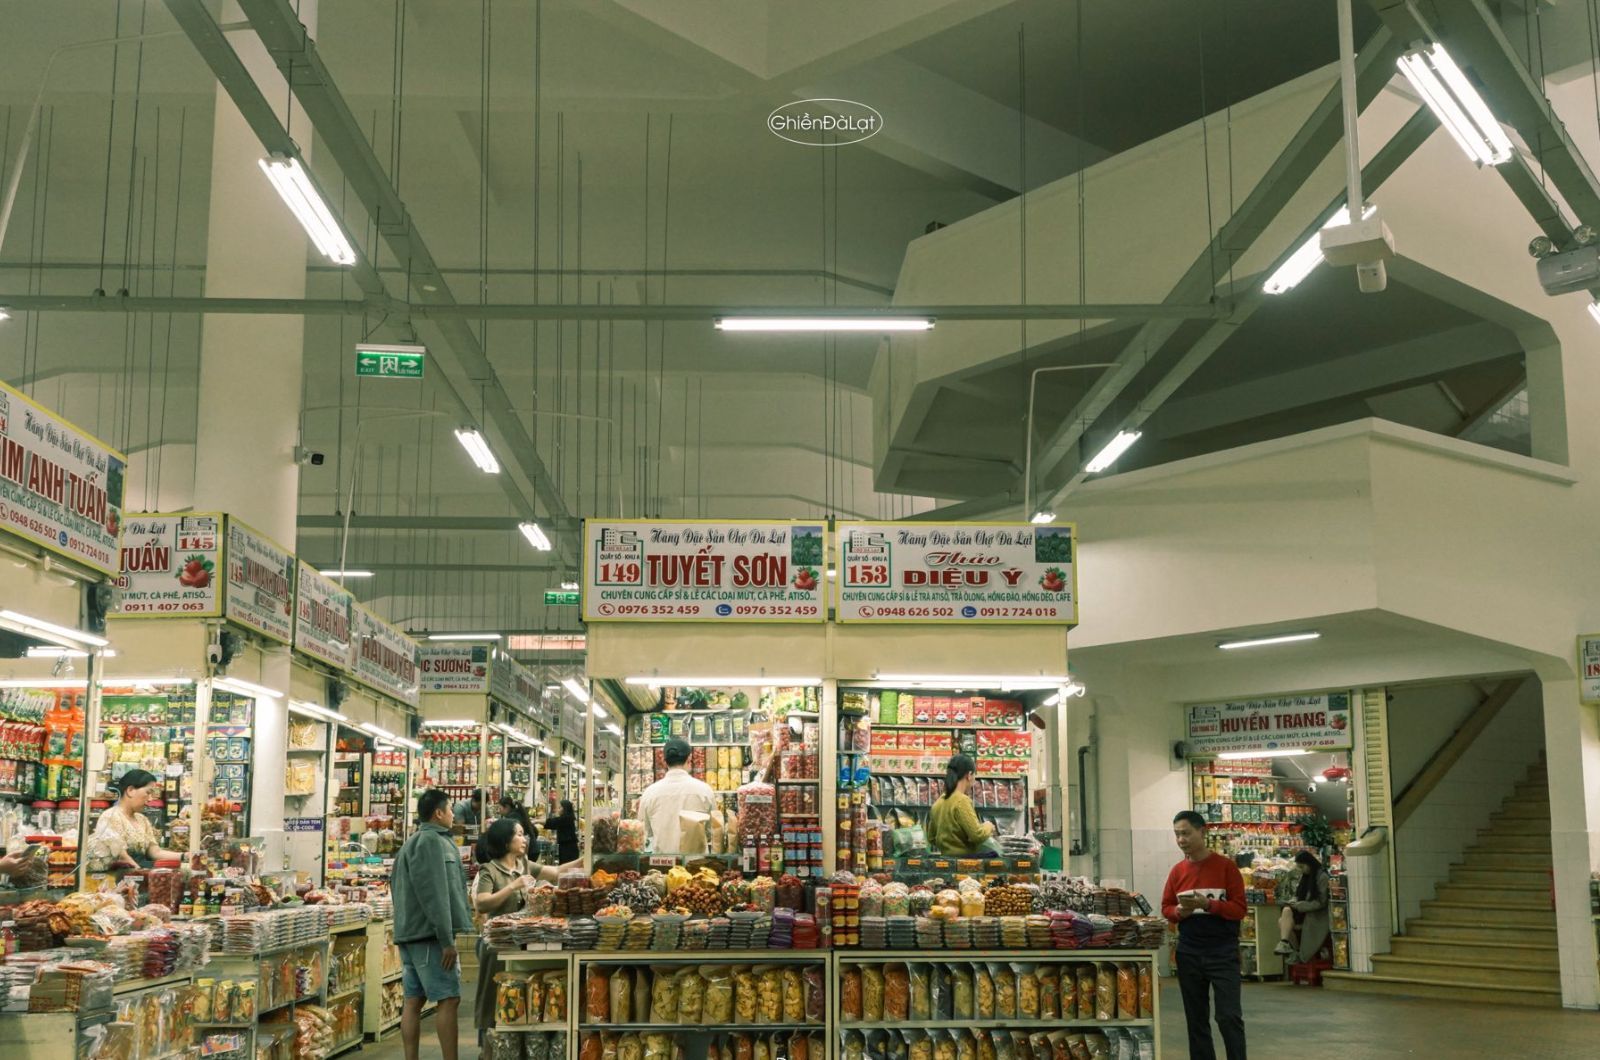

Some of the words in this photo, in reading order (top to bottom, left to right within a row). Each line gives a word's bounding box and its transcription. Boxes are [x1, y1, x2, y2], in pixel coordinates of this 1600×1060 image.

[0, 434, 24, 485] IM
[28, 452, 65, 505] ANH
[69, 472, 107, 526] TUẤN
[10, 510, 28, 528] 0948
[29, 519, 43, 534] 626
[44, 526, 57, 540] 502
[69, 537, 85, 553] 0912
[650, 528, 680, 546] Hàng
[682, 528, 703, 546] Đặc
[705, 528, 725, 544] Sản
[727, 528, 747, 546] Chợ
[749, 528, 765, 544] Đà
[767, 528, 786, 546] Lạt
[898, 530, 927, 548] Hàng
[929, 530, 950, 547] Đặc
[953, 530, 972, 545] Sản
[974, 530, 995, 547] Chợ
[996, 530, 1012, 545] Đà
[1014, 530, 1032, 548] Lạt
[179, 537, 214, 549] 145
[120, 538, 169, 571] TUẤN
[600, 562, 640, 582] 149
[647, 545, 725, 586] TUYẾT
[733, 552, 787, 586] SƠN
[848, 565, 888, 584] 153
[904, 567, 988, 589] DIỆU
[1002, 567, 1023, 585] Ý
[601, 589, 633, 600] CHUYÊN
[634, 590, 656, 600] CUNG
[657, 588, 673, 600] CẤP
[683, 591, 689, 600] &
[701, 589, 717, 600] CÁC
[718, 591, 735, 602] LOẠI
[757, 589, 768, 600] CÀ
[842, 591, 866, 601] CHUYÊN
[867, 592, 885, 601] CUNG
[886, 590, 897, 601] CẤP
[906, 592, 910, 600] &
[125, 603, 153, 611] 0911
[157, 603, 179, 611] 407
[617, 605, 648, 614] 0976
[651, 605, 674, 614] 352
[676, 605, 700, 614] 459
[736, 605, 766, 615] 0976
[769, 606, 792, 614] 352
[795, 606, 817, 614] 459
[877, 607, 905, 616] 0948
[908, 607, 930, 616] 626
[932, 607, 953, 616] 502
[980, 607, 1008, 616] 0912
[1012, 607, 1033, 616] 724
[1035, 607, 1057, 616] 018
[433, 657, 471, 673] SƯƠNG
[1274, 711, 1326, 729] TRANG
